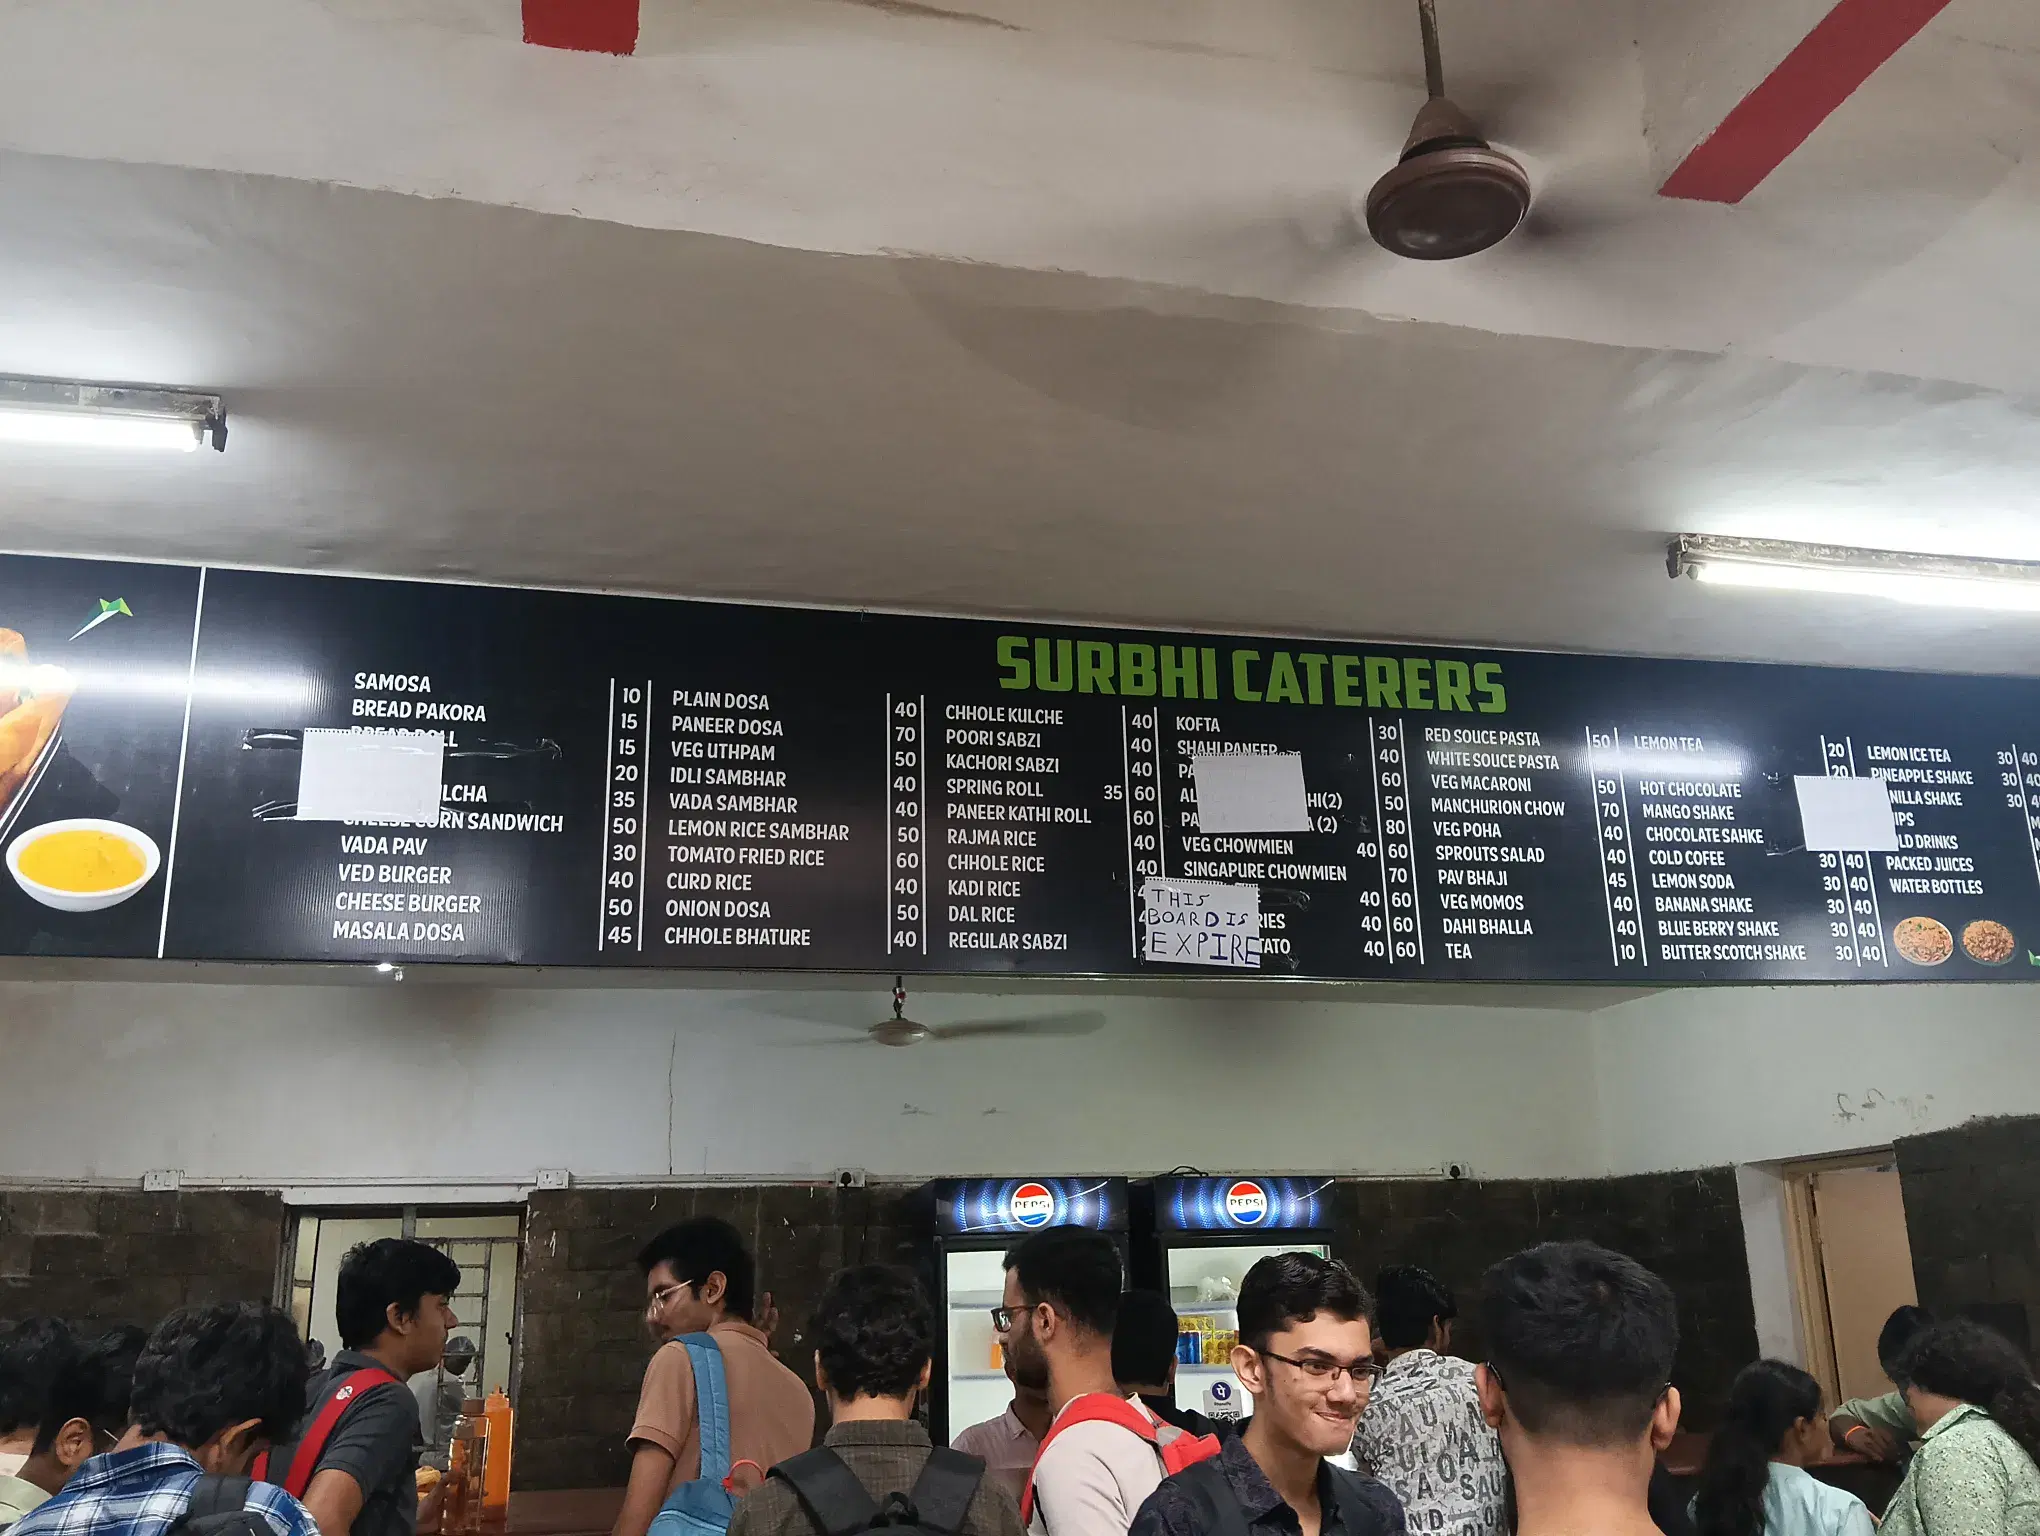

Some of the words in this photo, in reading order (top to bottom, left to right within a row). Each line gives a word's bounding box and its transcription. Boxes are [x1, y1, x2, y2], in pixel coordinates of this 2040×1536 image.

[355, 672, 430, 692] SAMOSA
[996, 636, 1217, 700] SURBHI
[1232, 649, 1507, 714] CATERERS
[624, 688, 640, 703] 10
[673, 690, 720, 708] PLAIN
[725, 693, 769, 710] DOSA
[352, 699, 412, 718] BREAD
[416, 702, 486, 722] PAKORA
[895, 702, 916, 717] 40
[946, 705, 1005, 721] CHHOLE
[1008, 708, 1063, 724] KULCHE
[672, 716, 734, 733] PANEER
[739, 719, 783, 736] DOSA
[1132, 714, 1152, 728] 40
[1176, 716, 1220, 732] KOFTA
[947, 729, 993, 745] POORI
[997, 732, 1040, 748] SABZI
[1379, 726, 1396, 740] 30
[1425, 728, 1450, 742] RED
[1454, 729, 1497, 744] SOUCE
[1500, 731, 1540, 746] PASTA
[620, 739, 635, 755] 15
[672, 741, 703, 758] VEG
[708, 743, 774, 760] UTHPAM
[1634, 736, 1677, 749] LEMON
[1679, 737, 1703, 750] TEA
[896, 752, 916, 766] 50
[1380, 749, 1399, 763] 40
[1427, 751, 1470, 766] WHITE
[1473, 753, 1516, 768] SOUCE
[1518, 755, 1559, 769] PASTA
[1868, 746, 1908, 761] LEMON
[1910, 748, 1928, 761] ICE
[1928, 748, 1951, 762] TEA
[1997, 752, 2013, 764] 30
[947, 754, 1011, 771] KACHORI
[1016, 757, 1058, 773] SABZI
[1132, 762, 1152, 776] 40
[671, 767, 701, 783] IDLI
[706, 768, 786, 786] SAMBHAR
[1432, 774, 1458, 789] VEG
[1461, 776, 1531, 791] MACARONI
[1935, 770, 1974, 784] SHAKE
[947, 778, 1002, 795] SPRING
[1007, 781, 1043, 796] ROLL
[1104, 785, 1122, 800] 35
[1640, 781, 1665, 795] HOT
[1668, 782, 1741, 798] CHOCOLATE
[614, 791, 635, 807] 35
[670, 793, 713, 810] VADA
[717, 795, 797, 813] SAMBHAR
[1385, 796, 1403, 810] 50
[1924, 791, 1962, 806] SHAKE
[896, 802, 917, 817] 40
[948, 804, 1005, 820] PANEER
[1009, 806, 1050, 822] KATHI
[1055, 808, 1091, 823] ROLL
[1432, 798, 1522, 814] MANCHURION
[1525, 801, 1564, 816] CHOW
[1602, 803, 1619, 817] 70
[1643, 804, 1690, 819] MANGO
[1693, 805, 1734, 820] SHAKE
[468, 813, 563, 832] SANDWICH
[669, 820, 726, 836] LEMON
[730, 822, 766, 838] RICE
[770, 823, 849, 840] SAMBHAR
[1433, 822, 1460, 836] VEG
[1463, 822, 1502, 838] POHA
[948, 829, 1000, 845] RAJMA
[1004, 831, 1036, 846] RICE
[1134, 835, 1154, 850] 40
[1646, 827, 1720, 842] CHOCOLATE
[1722, 828, 1764, 843] SAHKE
[1915, 834, 1958, 849] DRINKS
[342, 836, 388, 854] VADA
[393, 838, 427, 855] PAV
[613, 844, 636, 861] 30
[1182, 836, 1210, 854] VEG
[1214, 838, 1293, 854] CHOWMIEN
[1388, 844, 1408, 858] 60
[668, 846, 735, 863] TOMATO
[740, 848, 785, 864] FRIED
[790, 850, 824, 866] RICE
[897, 853, 918, 868] 60
[1436, 846, 1498, 861] SPROUTS
[1500, 847, 1544, 862] SALAD
[1607, 849, 1626, 864] 40
[1649, 850, 1684, 865] COLD
[1686, 850, 1725, 865] COFEE
[1846, 854, 1864, 868] 40
[948, 854, 1008, 870] CHHOLE
[1012, 856, 1044, 872] RICE
[1184, 861, 1265, 878] SINGAPURE
[1268, 864, 1346, 881] CHOWMIEN
[1886, 856, 1932, 871] PACKED
[1934, 857, 1974, 872] JUICES
[339, 864, 374, 882] VED
[379, 865, 451, 884] BURGER
[667, 873, 711, 890] CURD
[716, 874, 751, 890] RICE
[1438, 870, 1464, 884] PAV
[1467, 870, 1507, 886] BHAJI
[1652, 873, 1697, 888] LEMON
[1699, 874, 1734, 889] SODA
[949, 880, 983, 896] KADI
[988, 881, 1020, 896] RICE
[1823, 876, 1841, 890] 30
[1889, 878, 1930, 893] WATER
[1931, 879, 1983, 894] BOTTLES
[336, 892, 405, 911] CHEESE
[408, 894, 481, 913] BURGER
[1152, 889, 1210, 907] THIS
[1360, 891, 1380, 906] 40
[1392, 892, 1411, 907] 60
[1440, 894, 1468, 909] VEG
[1471, 894, 1524, 910] MOMOS
[1614, 896, 1632, 911] 40
[1655, 897, 1710, 912] BANANA
[1711, 897, 1753, 912] SHAKE
[609, 899, 632, 915] 50
[666, 900, 720, 916] ONION
[725, 901, 770, 918] DOSA
[898, 905, 918, 920] 50
[949, 906, 978, 922] DAL
[984, 907, 1015, 922] RICE
[1854, 900, 1872, 914] 40
[1148, 908, 1219, 927] BOARD
[1226, 912, 1248, 926] IS
[333, 921, 409, 940] MASALA
[414, 923, 464, 941] DOSA
[1443, 918, 1476, 934] DAHI
[1479, 919, 1533, 934] BHALLA
[1658, 920, 1691, 936] BLUE
[1693, 921, 1734, 936] BERRY
[1737, 921, 1779, 936] SHAKE
[1858, 923, 1875, 937] 40
[665, 927, 732, 944] CHHOLE
[736, 928, 810, 945] BHATURE
[950, 932, 1018, 949] REGULAR
[1022, 934, 1066, 950] SABZI
[1152, 932, 1260, 965] EXPIRE
[1396, 942, 1416, 957] 60
[1445, 943, 1472, 958] TEA
[1621, 944, 1635, 959] 10
[1662, 944, 1712, 960] BUTTER
[1713, 945, 1762, 960] SCOTCH
[1764, 945, 1806, 960] SHAKE
[1835, 946, 1852, 960] 30
[1015, 1200, 1051, 1210] PEPSI
[1230, 1199, 1264, 1208] PEPSI
